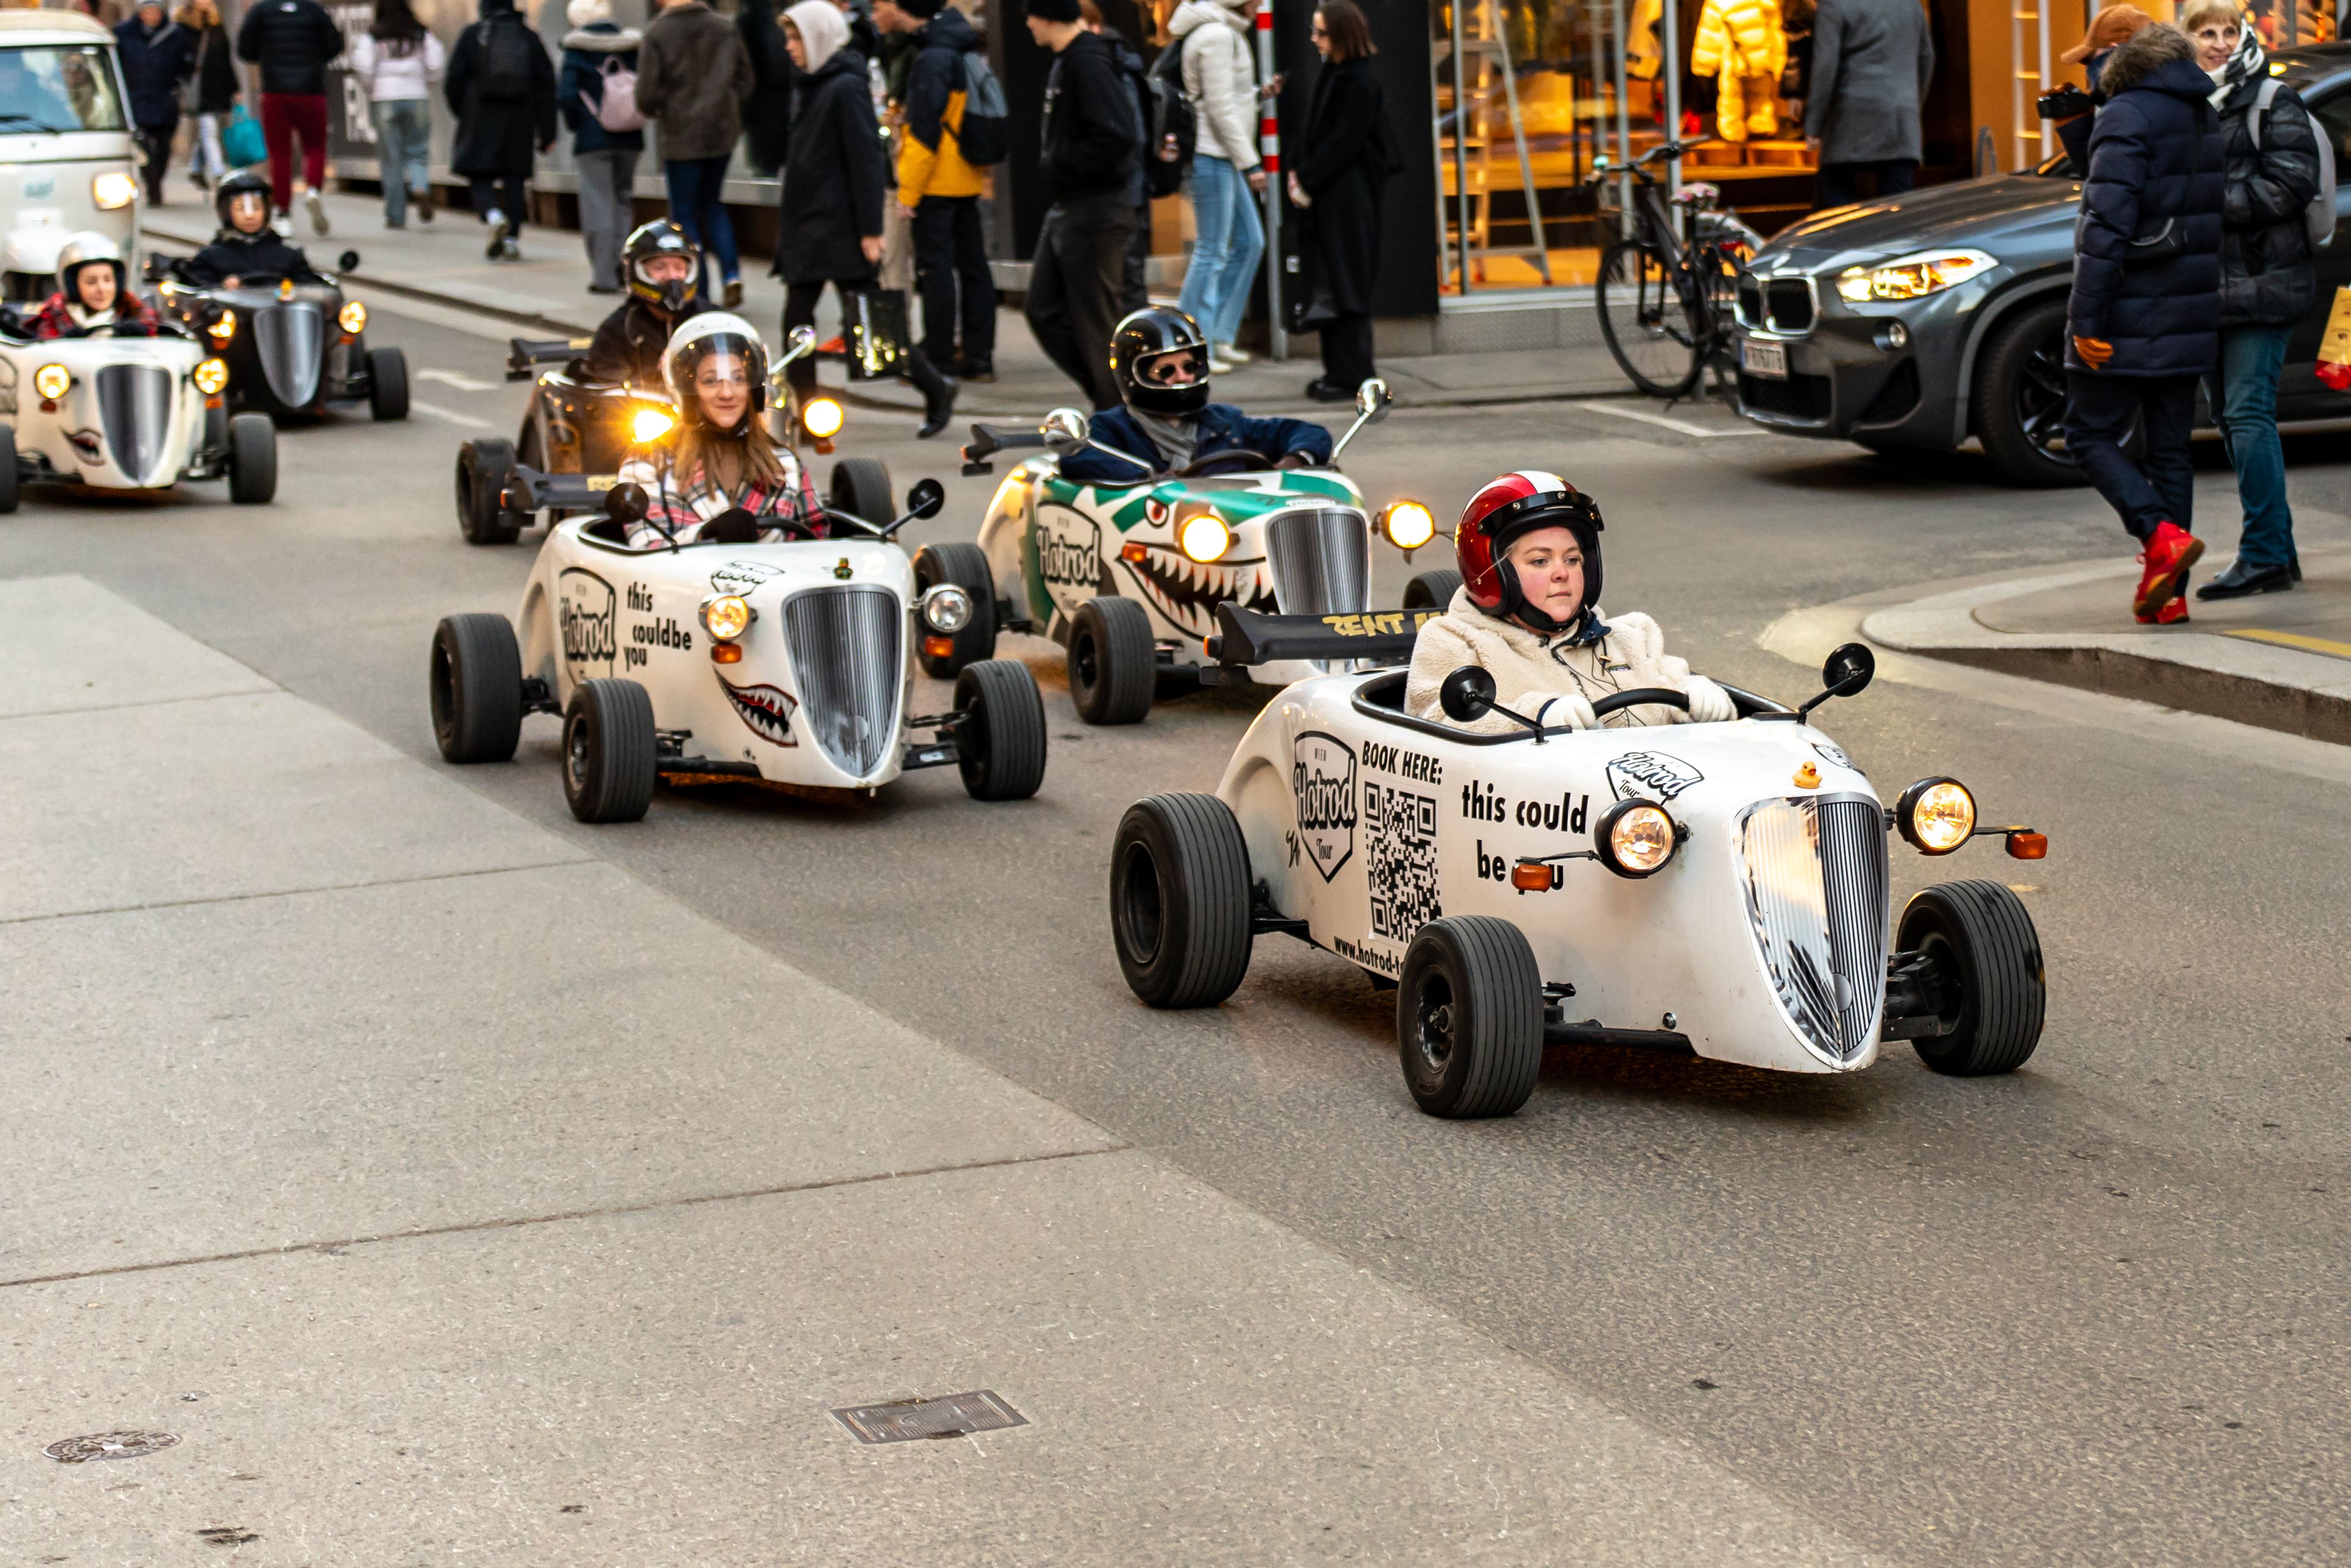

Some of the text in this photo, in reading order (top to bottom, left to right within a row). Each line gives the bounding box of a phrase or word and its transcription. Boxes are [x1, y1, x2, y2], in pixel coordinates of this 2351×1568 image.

[1036, 526, 1102, 587] Hotrod
[627, 582, 652, 612] this
[633, 617, 692, 651] couldbe
[624, 646, 647, 673] you
[1315, 747, 1327, 762] WIEN
[1362, 740, 1442, 785] BOOK HERE:
[1293, 762, 1357, 830] Hotrod
[1608, 752, 1704, 800] Hotrod
[1619, 780, 1640, 798] Tour
[1462, 780, 1589, 834] this could
[1316, 838, 1332, 860] Tour
[1476, 839, 1506, 882] be
[1334, 936, 1403, 976] www.hotrod-t
